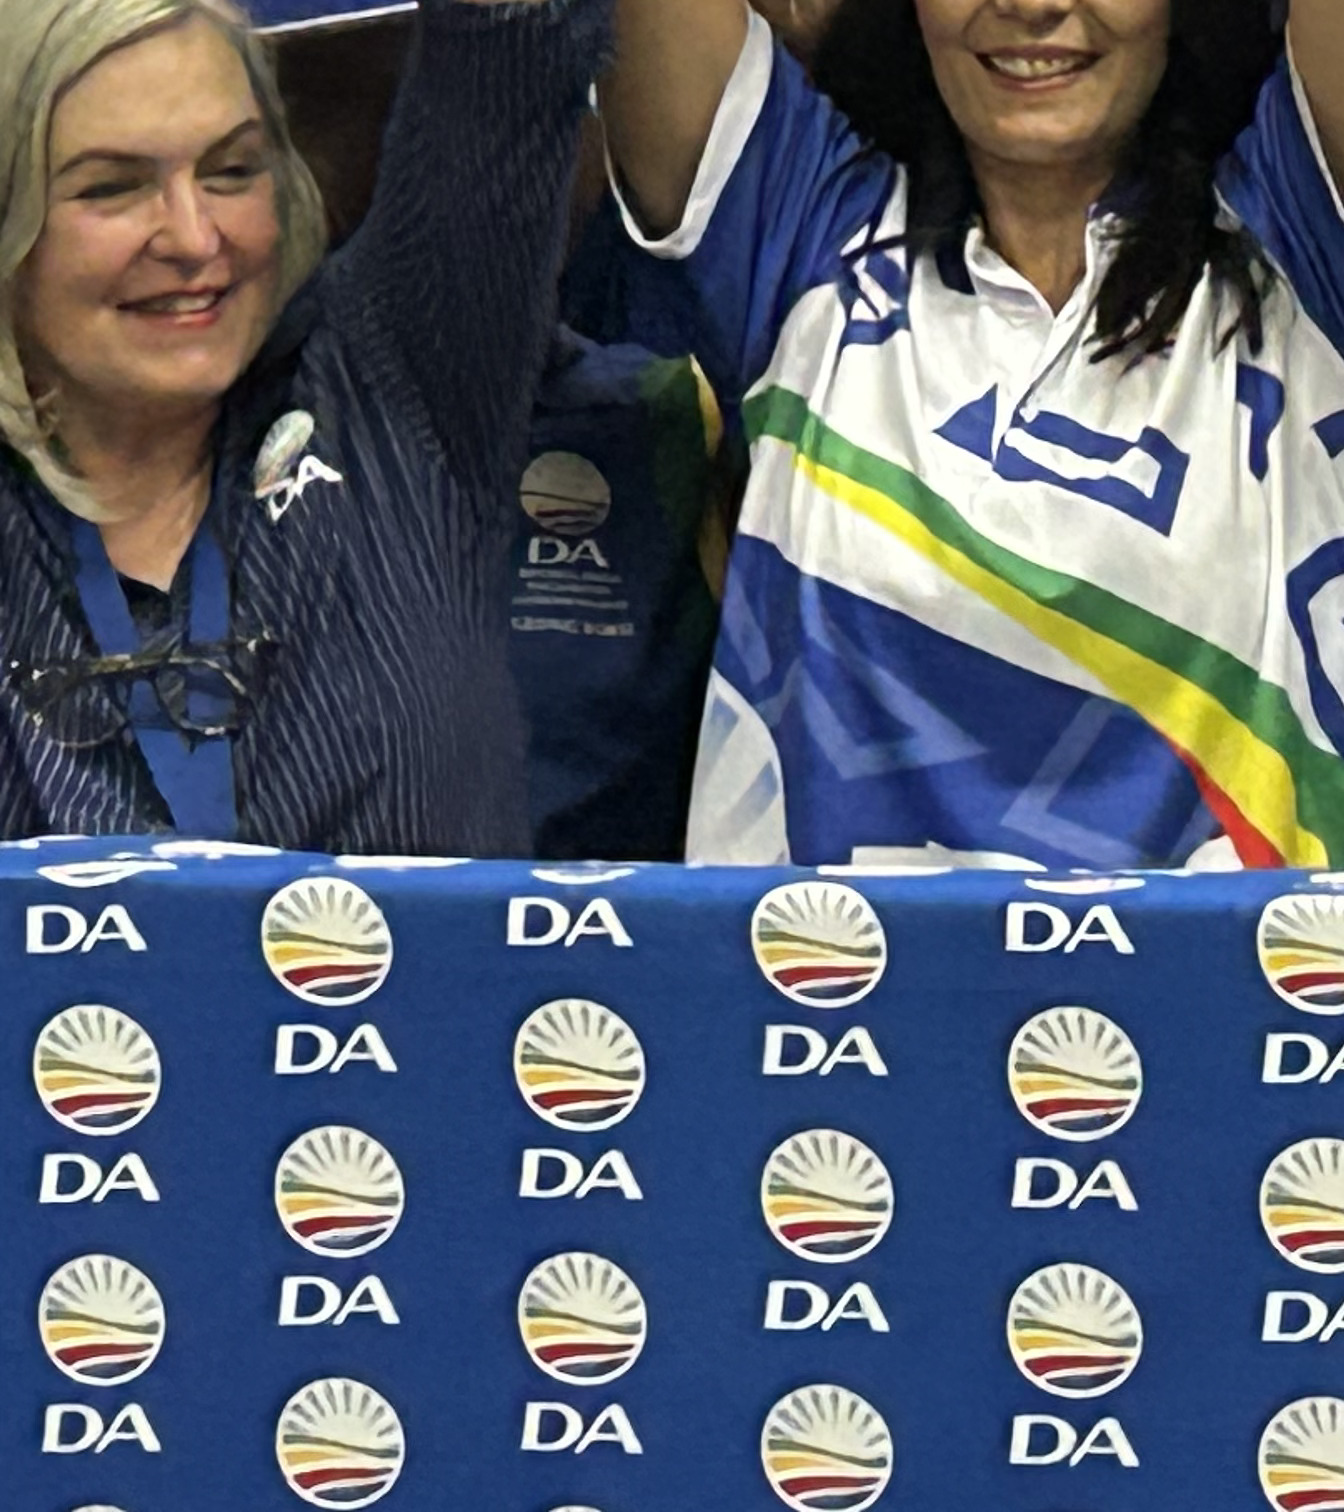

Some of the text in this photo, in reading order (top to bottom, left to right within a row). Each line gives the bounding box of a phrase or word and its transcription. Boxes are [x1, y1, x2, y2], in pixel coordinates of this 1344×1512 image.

[528, 536, 610, 569] DA
[27, 903, 147, 954] DA
[507, 896, 634, 947] DA
[1006, 901, 1135, 955] DA
[275, 1023, 398, 1075] DA
[763, 1024, 889, 1076] DA
[39, 1152, 160, 1204] DA
[520, 1148, 643, 1200] DA
[1011, 1157, 1139, 1211] DA
[279, 1274, 400, 1326] DA
[764, 1280, 890, 1332] DA
[42, 1403, 162, 1453] DA
[521, 1401, 643, 1455] DA
[1009, 1414, 1139, 1468] DA
